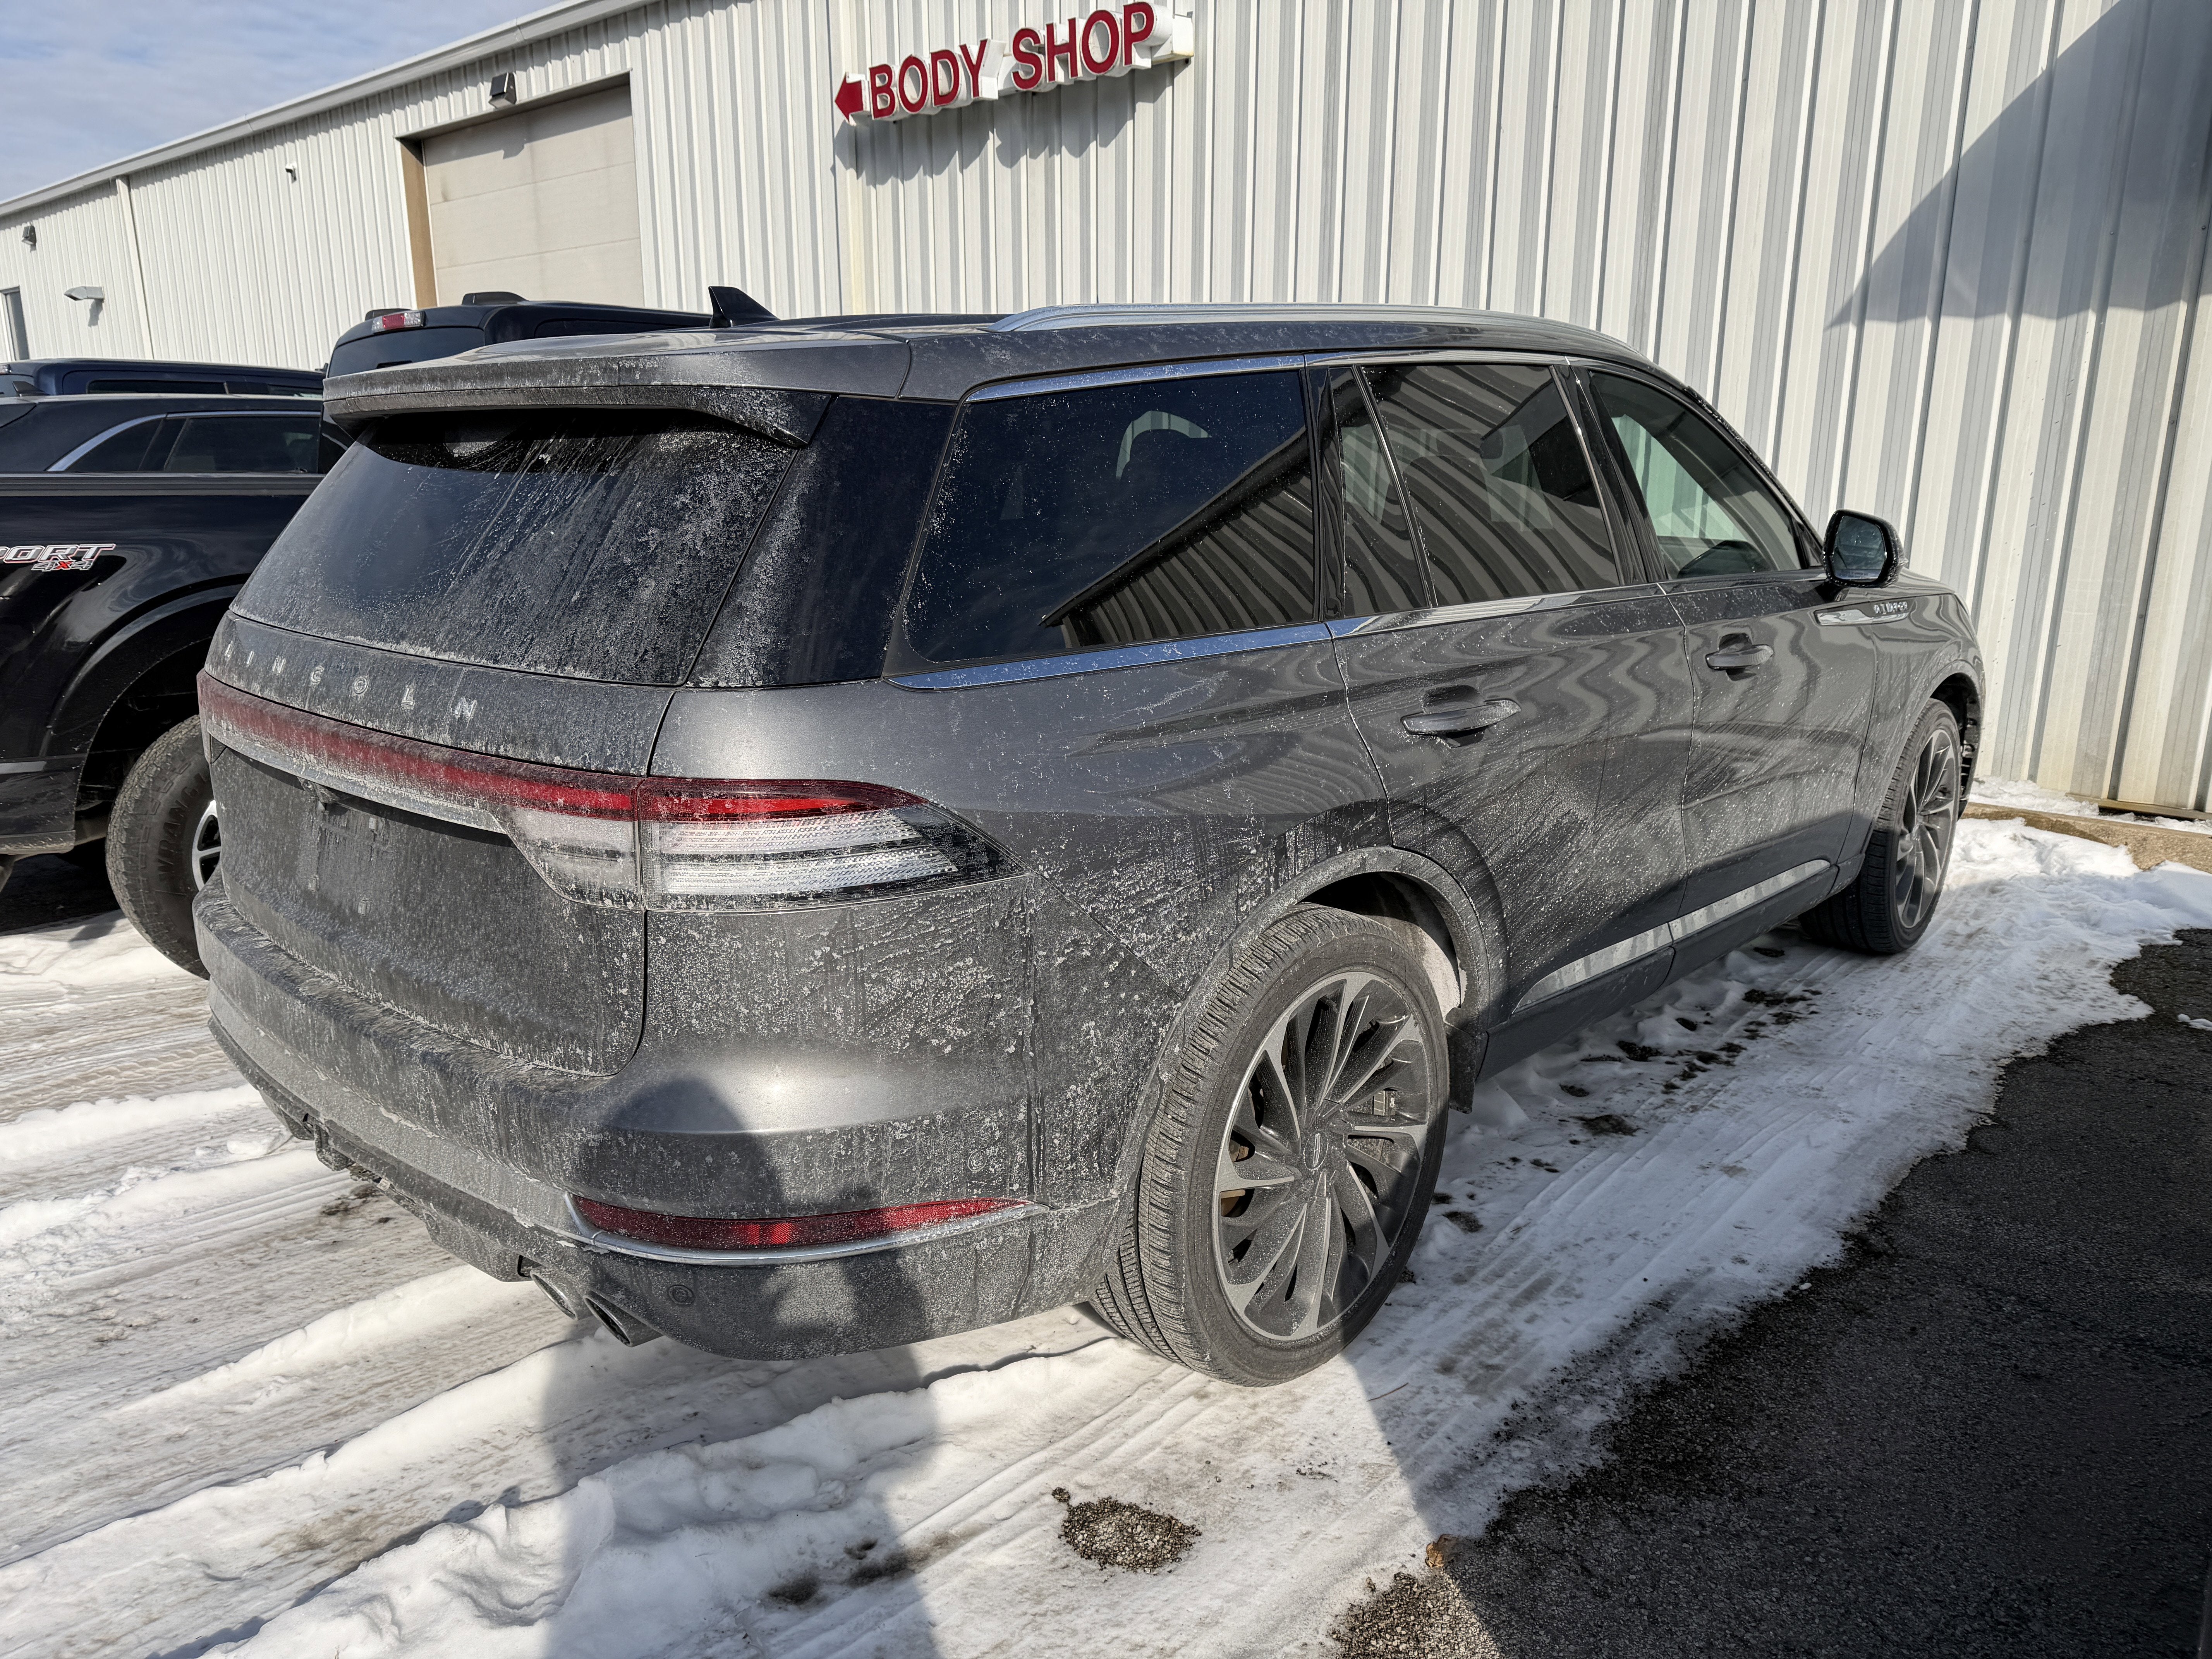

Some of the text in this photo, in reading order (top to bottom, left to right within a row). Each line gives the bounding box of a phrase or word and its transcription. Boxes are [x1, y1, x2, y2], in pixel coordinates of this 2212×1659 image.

[869, 1, 1156, 120] BODY SHOP
[225, 641, 477, 719] LINCOLN
